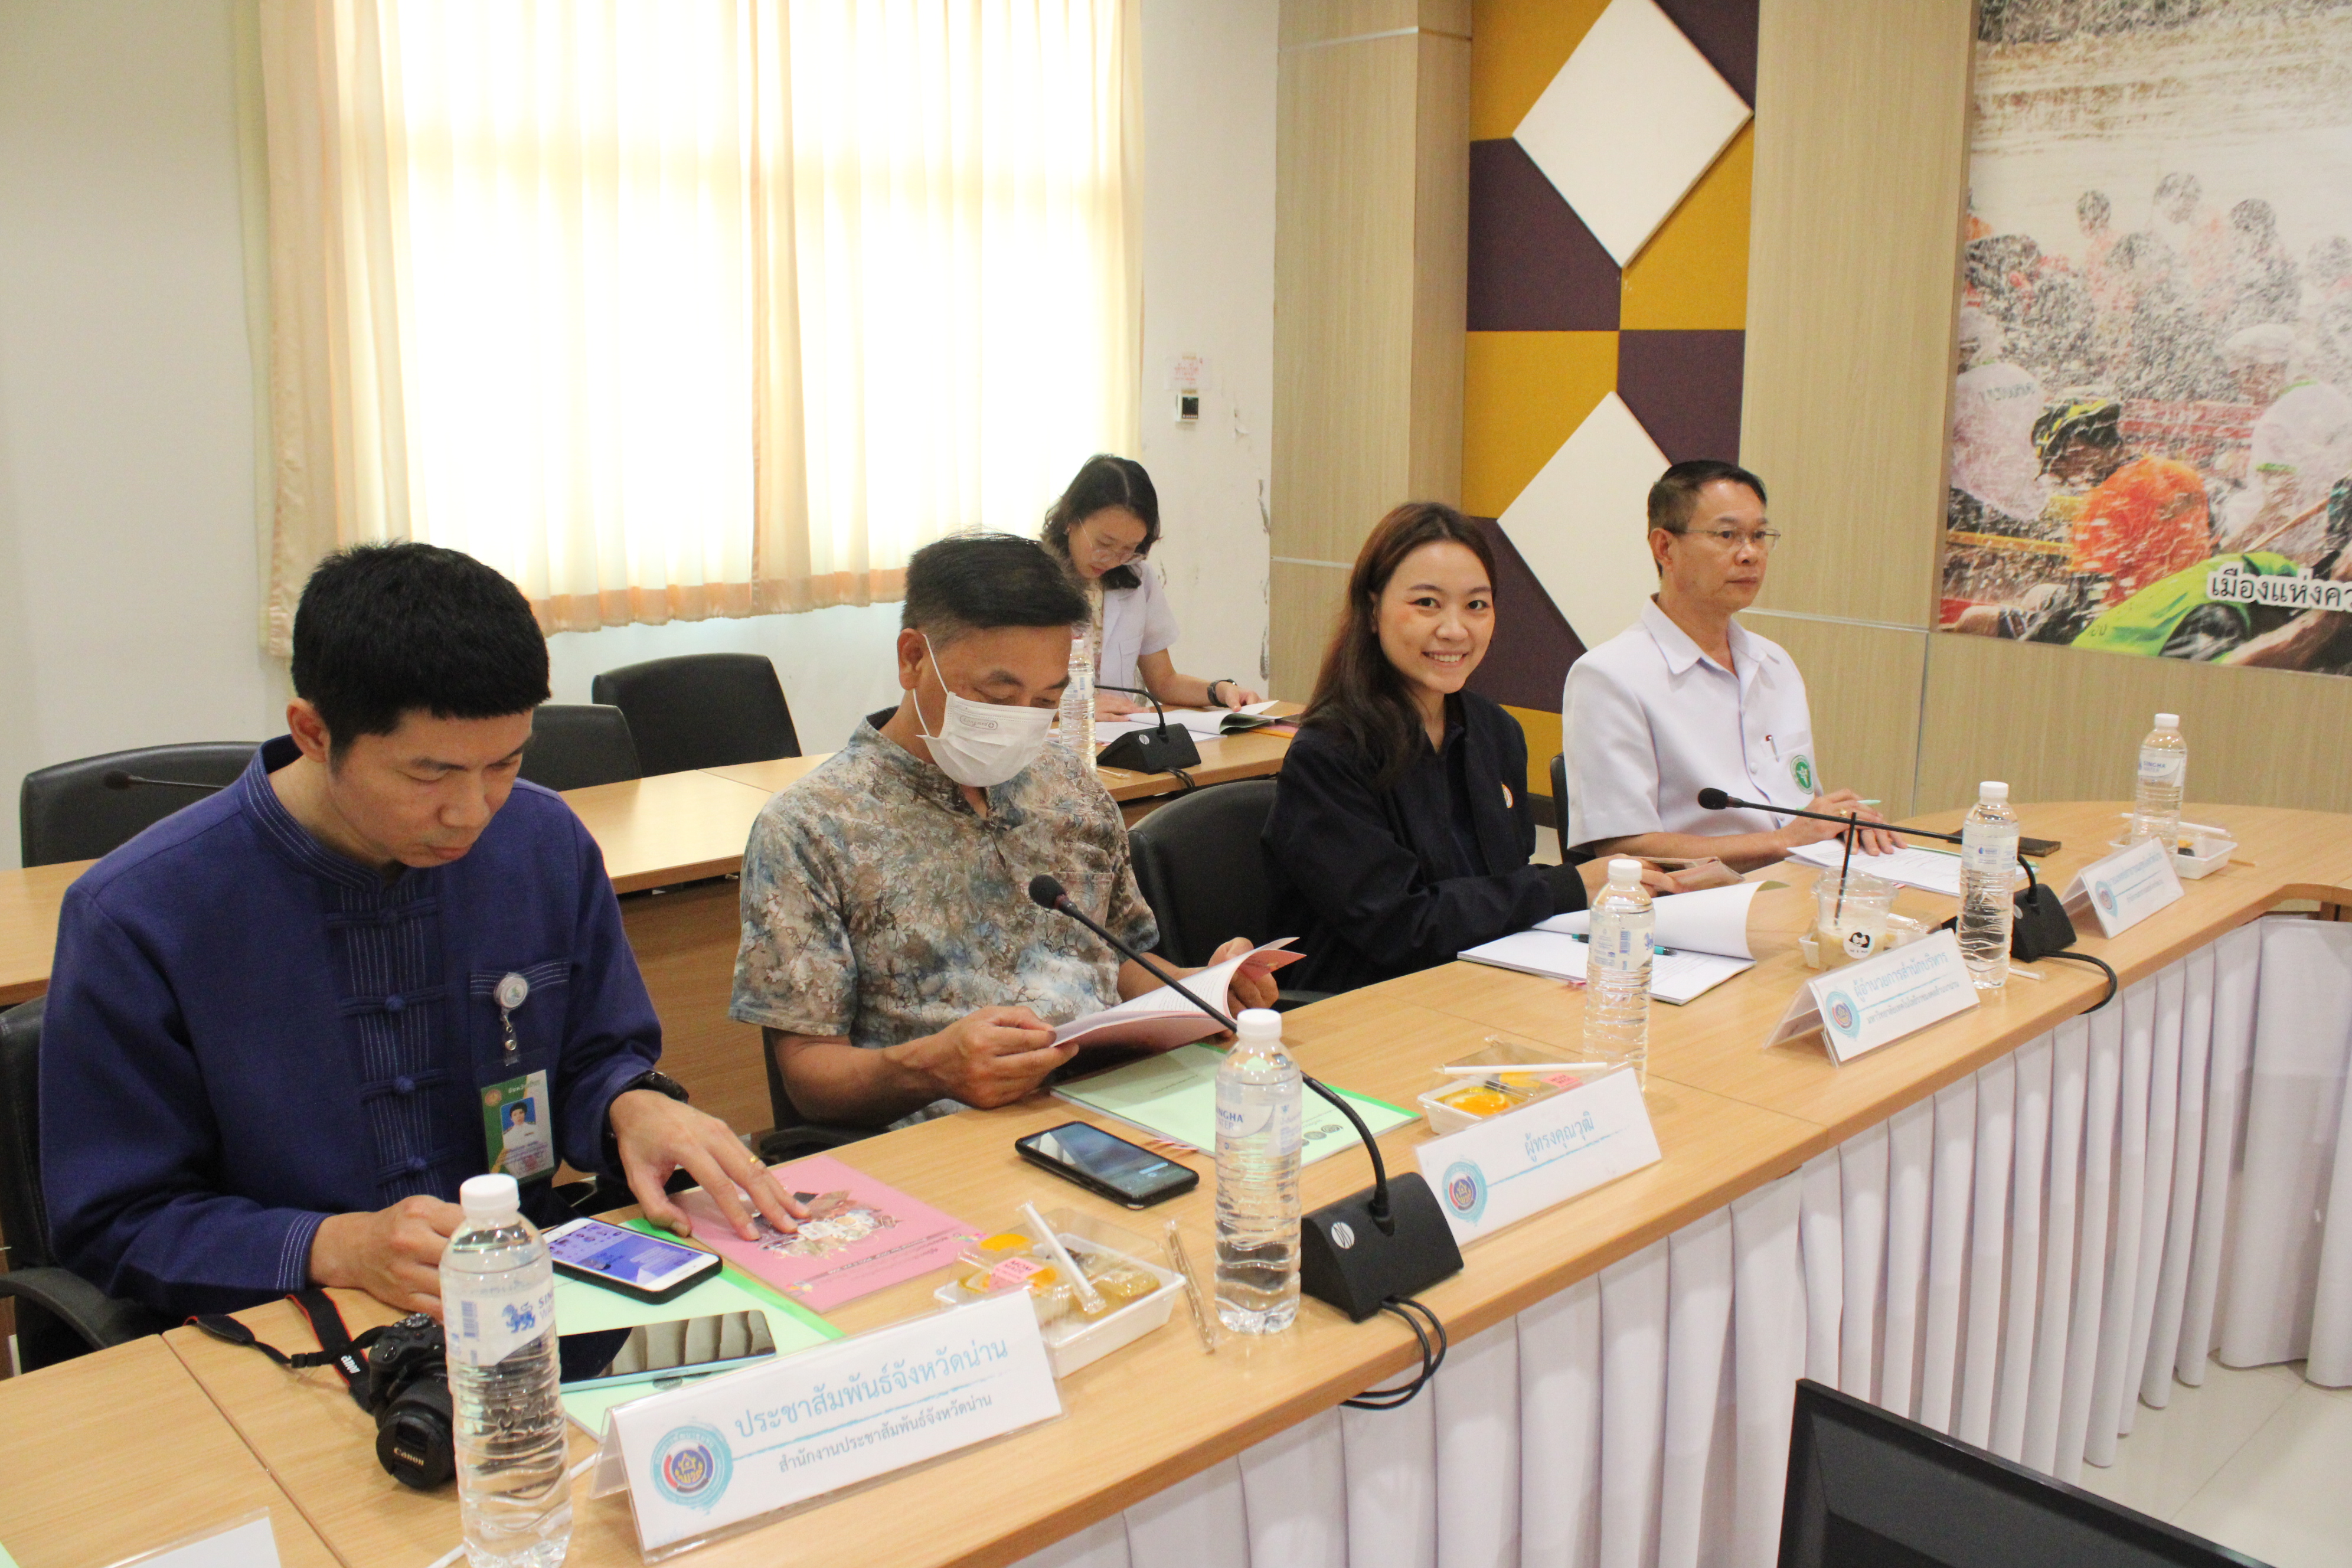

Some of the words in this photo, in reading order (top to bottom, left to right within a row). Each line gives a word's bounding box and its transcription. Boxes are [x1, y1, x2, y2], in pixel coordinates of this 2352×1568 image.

[1525, 1110, 1595, 1162] ผู้ทรงคุณวุฒิ
[734, 1339, 1008, 1438] ประชาสัมพันธ์จังหวัดน่าน
[394, 1446, 424, 1466] Canon
[779, 1393, 993, 1472] สำนักงานประชาสัมพันธ์จังหวัดน่าน
